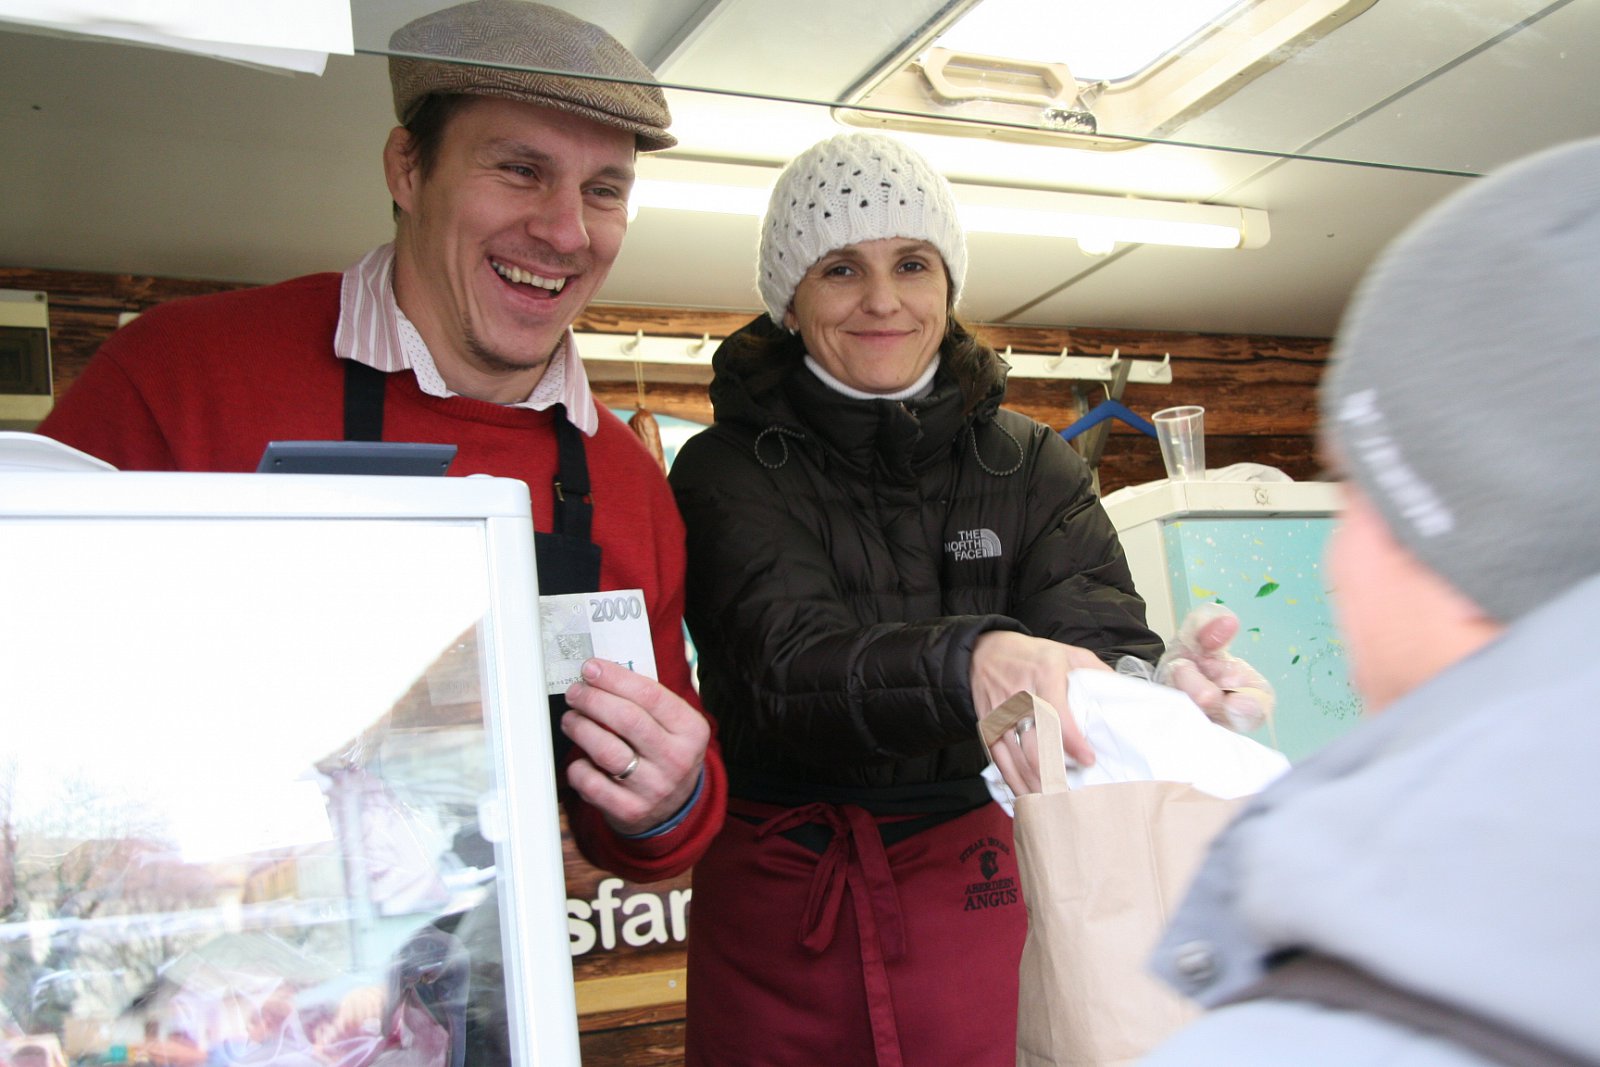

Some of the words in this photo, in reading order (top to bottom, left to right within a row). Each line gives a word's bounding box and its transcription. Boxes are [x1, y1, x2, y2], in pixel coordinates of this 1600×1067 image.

[957, 529, 980, 540] THE
[944, 539, 982, 552] NORTH
[954, 549, 983, 561] FACE
[590, 596, 641, 622] 2000
[964, 877, 1014, 895] ABERDEEN
[964, 888, 1018, 911] ANGUS
